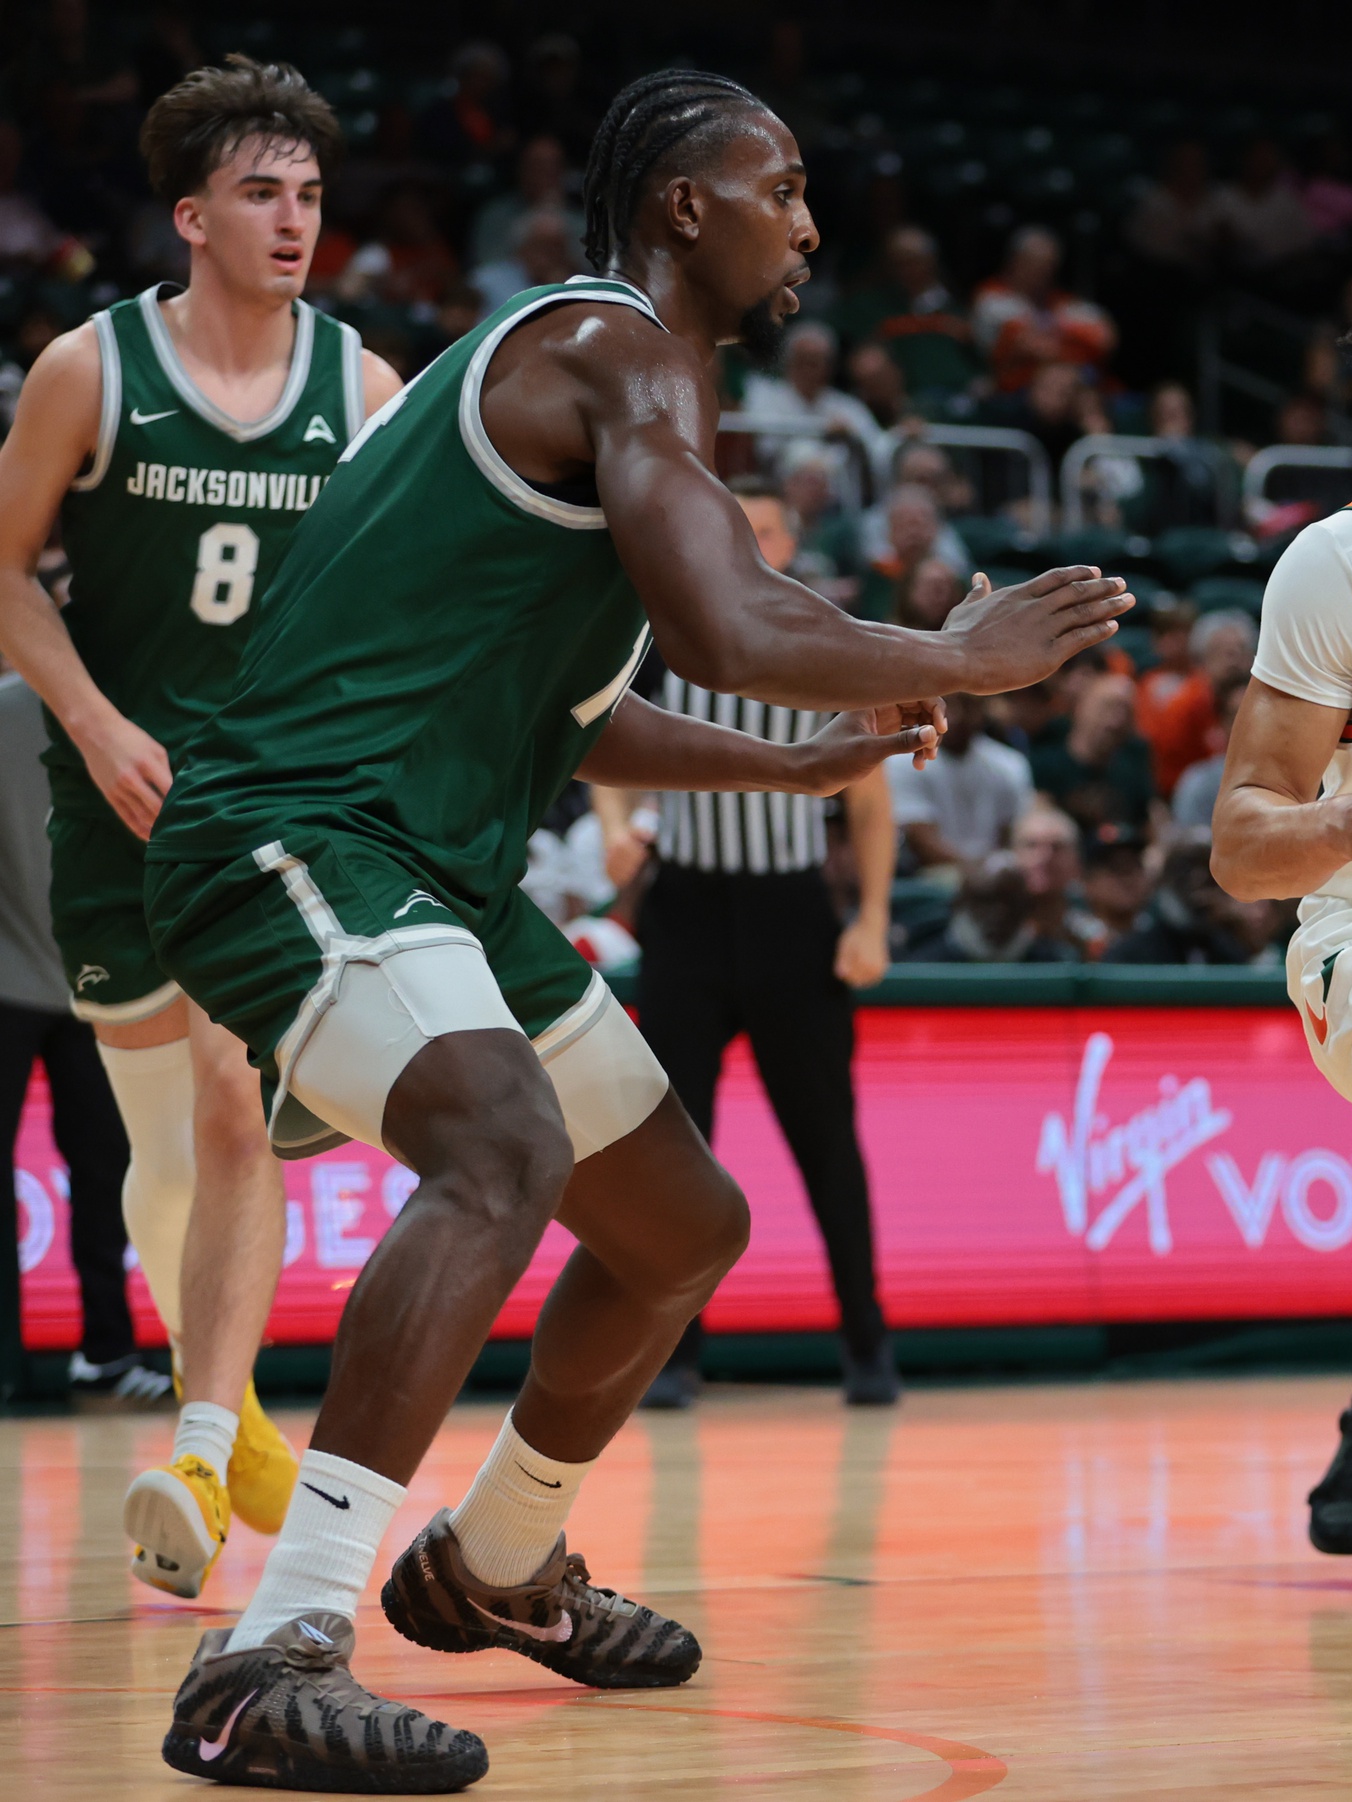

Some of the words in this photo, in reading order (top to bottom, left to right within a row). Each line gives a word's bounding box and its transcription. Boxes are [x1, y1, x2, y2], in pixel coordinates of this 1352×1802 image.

[127, 462, 331, 511] JACKSONVILL
[190, 522, 260, 626] 8
[1036, 1032, 1232, 1256] Virgin
[418, 1535, 436, 1582] TWELVE
